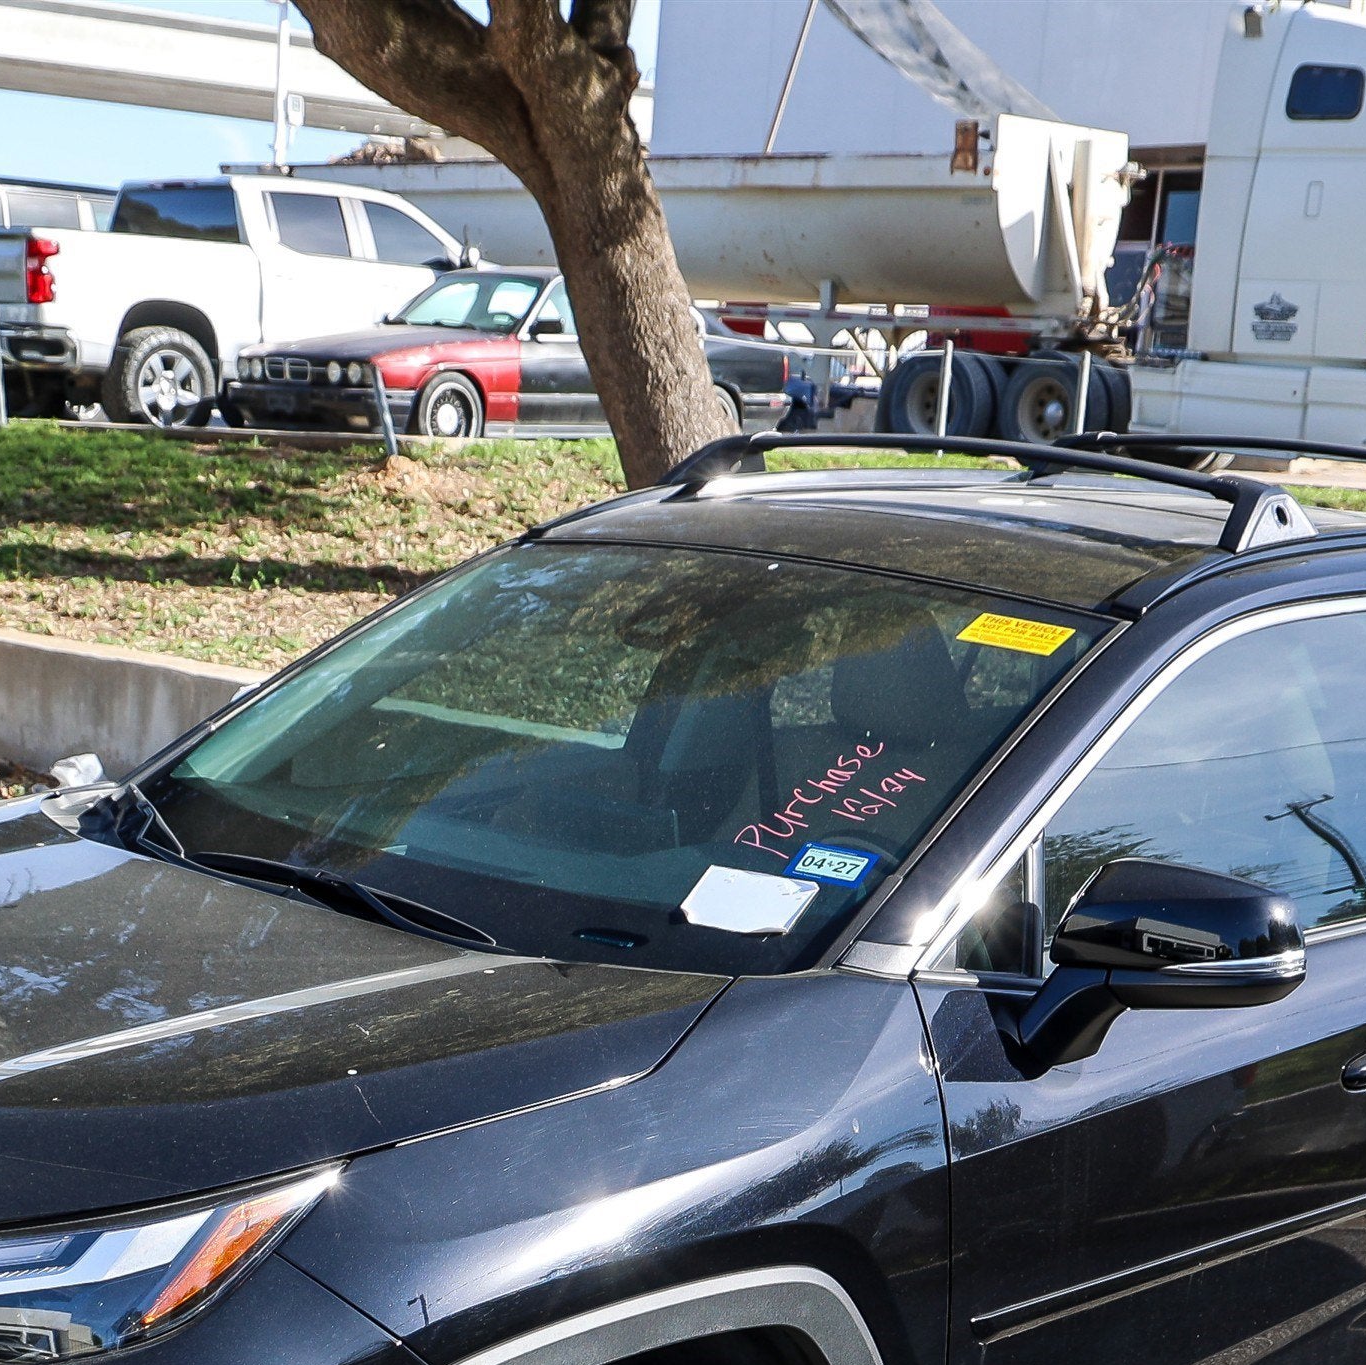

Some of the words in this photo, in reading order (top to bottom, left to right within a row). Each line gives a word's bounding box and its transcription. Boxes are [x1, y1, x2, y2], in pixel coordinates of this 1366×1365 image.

[979, 622, 1001, 631] NOT
[1004, 627, 1027, 635] FOR
[1029, 631, 1059, 641] SALE
[984, 615, 1013, 625] THIS
[1014, 621, 1067, 637] VEHICLE
